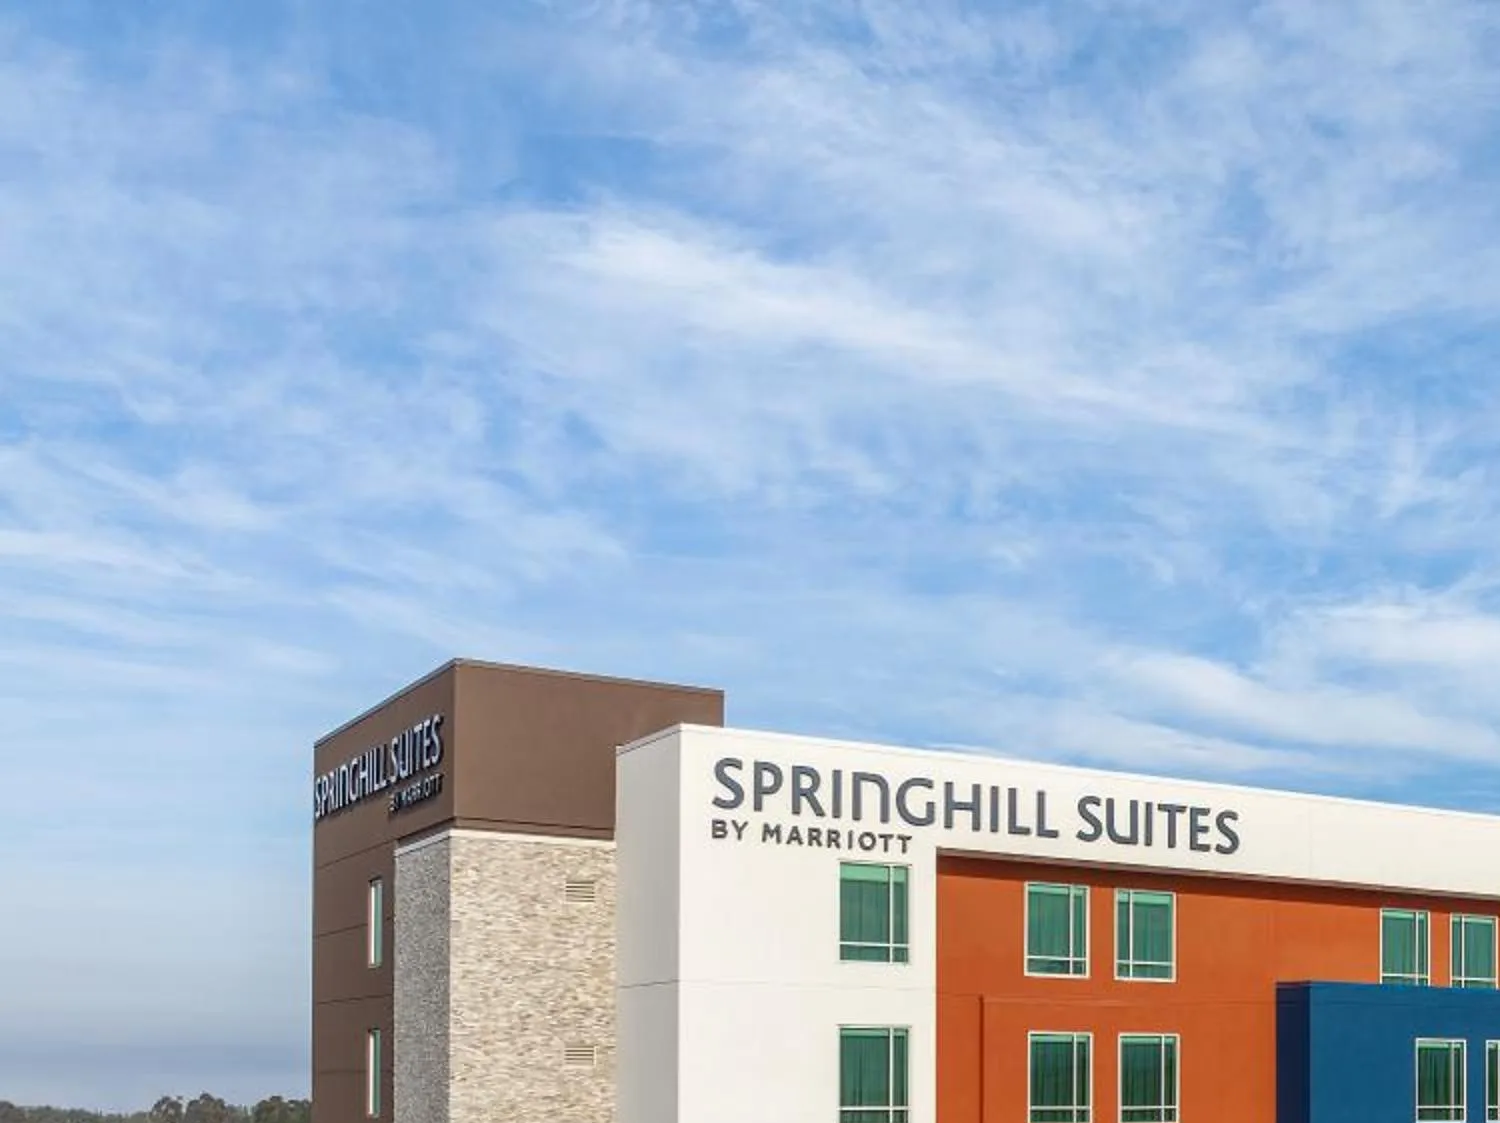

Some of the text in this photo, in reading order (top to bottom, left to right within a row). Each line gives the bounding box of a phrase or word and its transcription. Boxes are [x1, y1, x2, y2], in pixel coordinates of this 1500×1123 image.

[315, 714, 443, 820] SPRINGHILL SUITES
[711, 757, 1240, 855] SPRINGHILL SUITES
[711, 819, 913, 854] BY MARRIOTT
